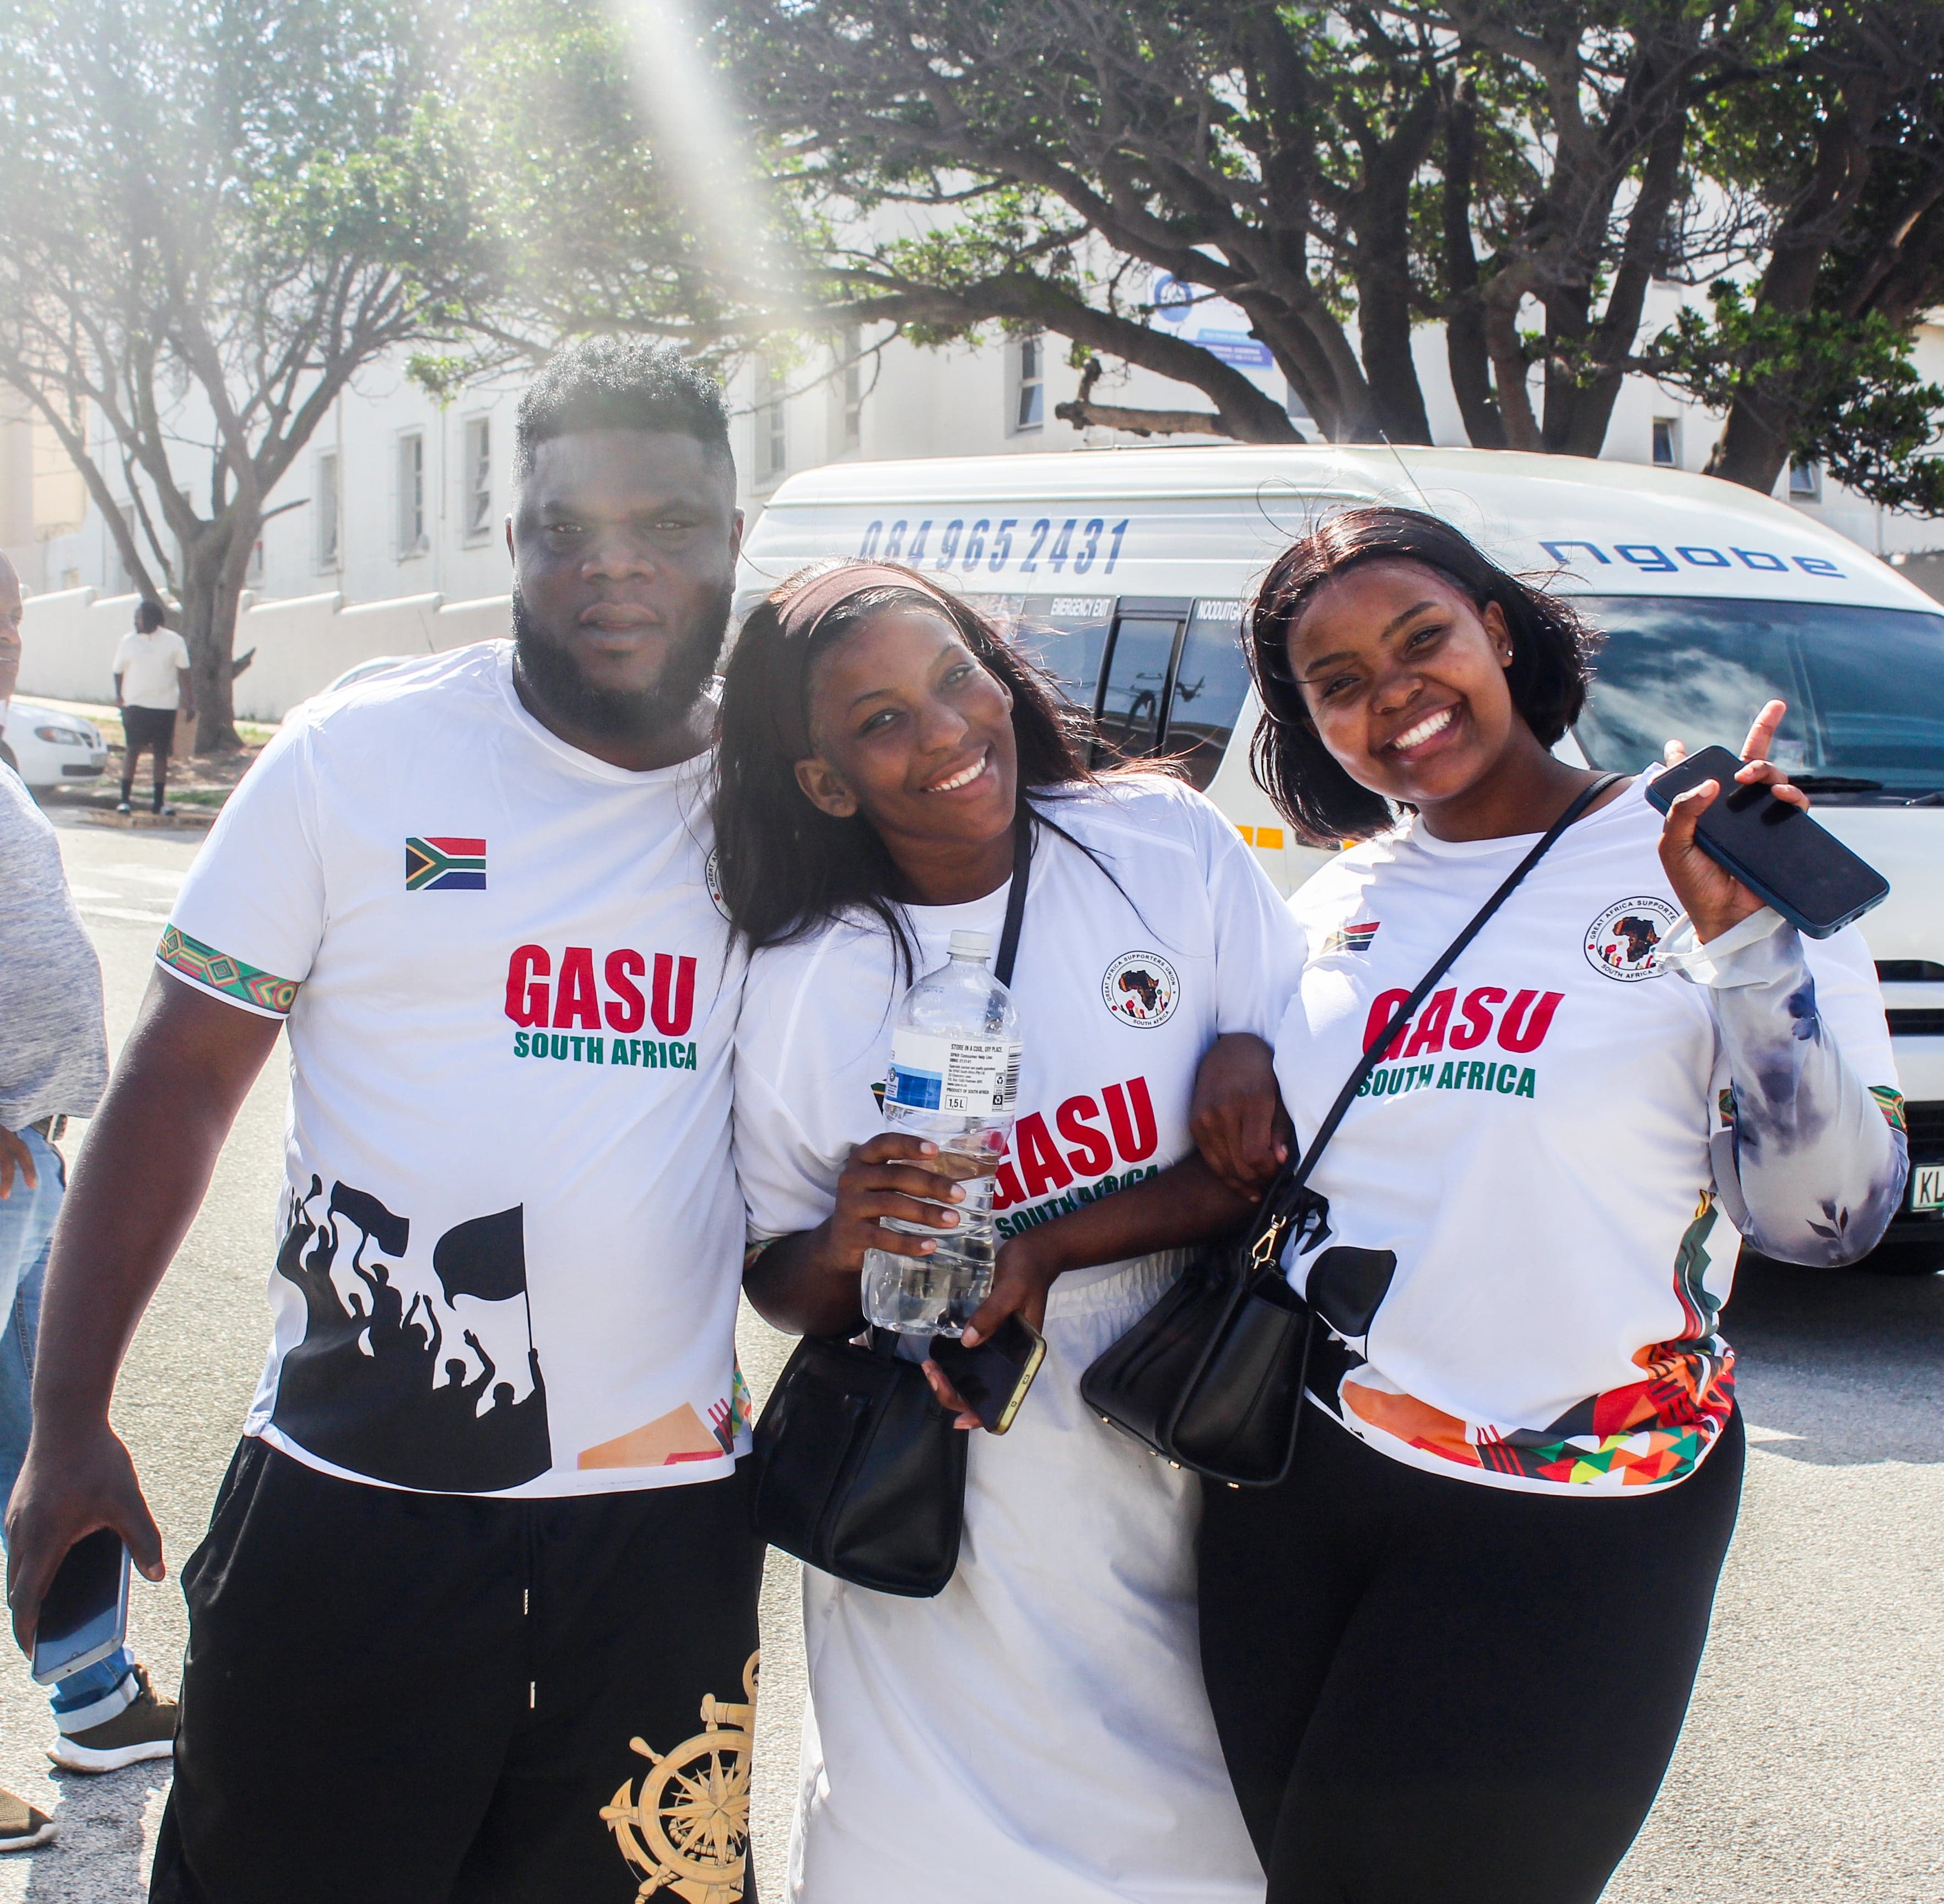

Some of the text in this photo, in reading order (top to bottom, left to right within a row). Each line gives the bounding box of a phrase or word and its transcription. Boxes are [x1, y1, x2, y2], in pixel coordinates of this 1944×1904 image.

[860, 518, 1129, 575] 084 965 2431
[1538, 540, 1847, 578] ngobe
[1050, 598, 1111, 616] EMERGENCY EXIT
[1590, 900, 1677, 939] GREAT AFRICA SUPPORTE
[1107, 961, 1122, 980] AFRICA
[1124, 954, 1165, 967] SUPPORTERS
[1165, 966, 1176, 986] UNION
[1601, 964, 1653, 979] SOUTH AFRICA
[505, 944, 697, 1036] GASU
[1153, 1010, 1170, 1025] AFRICA
[1362, 986, 1565, 1064] GASU
[514, 1031, 697, 1070] SOUTH AFRICA
[1356, 1061, 1536, 1099] SOUTH AFRICA
[959, 1099, 964, 1108] L
